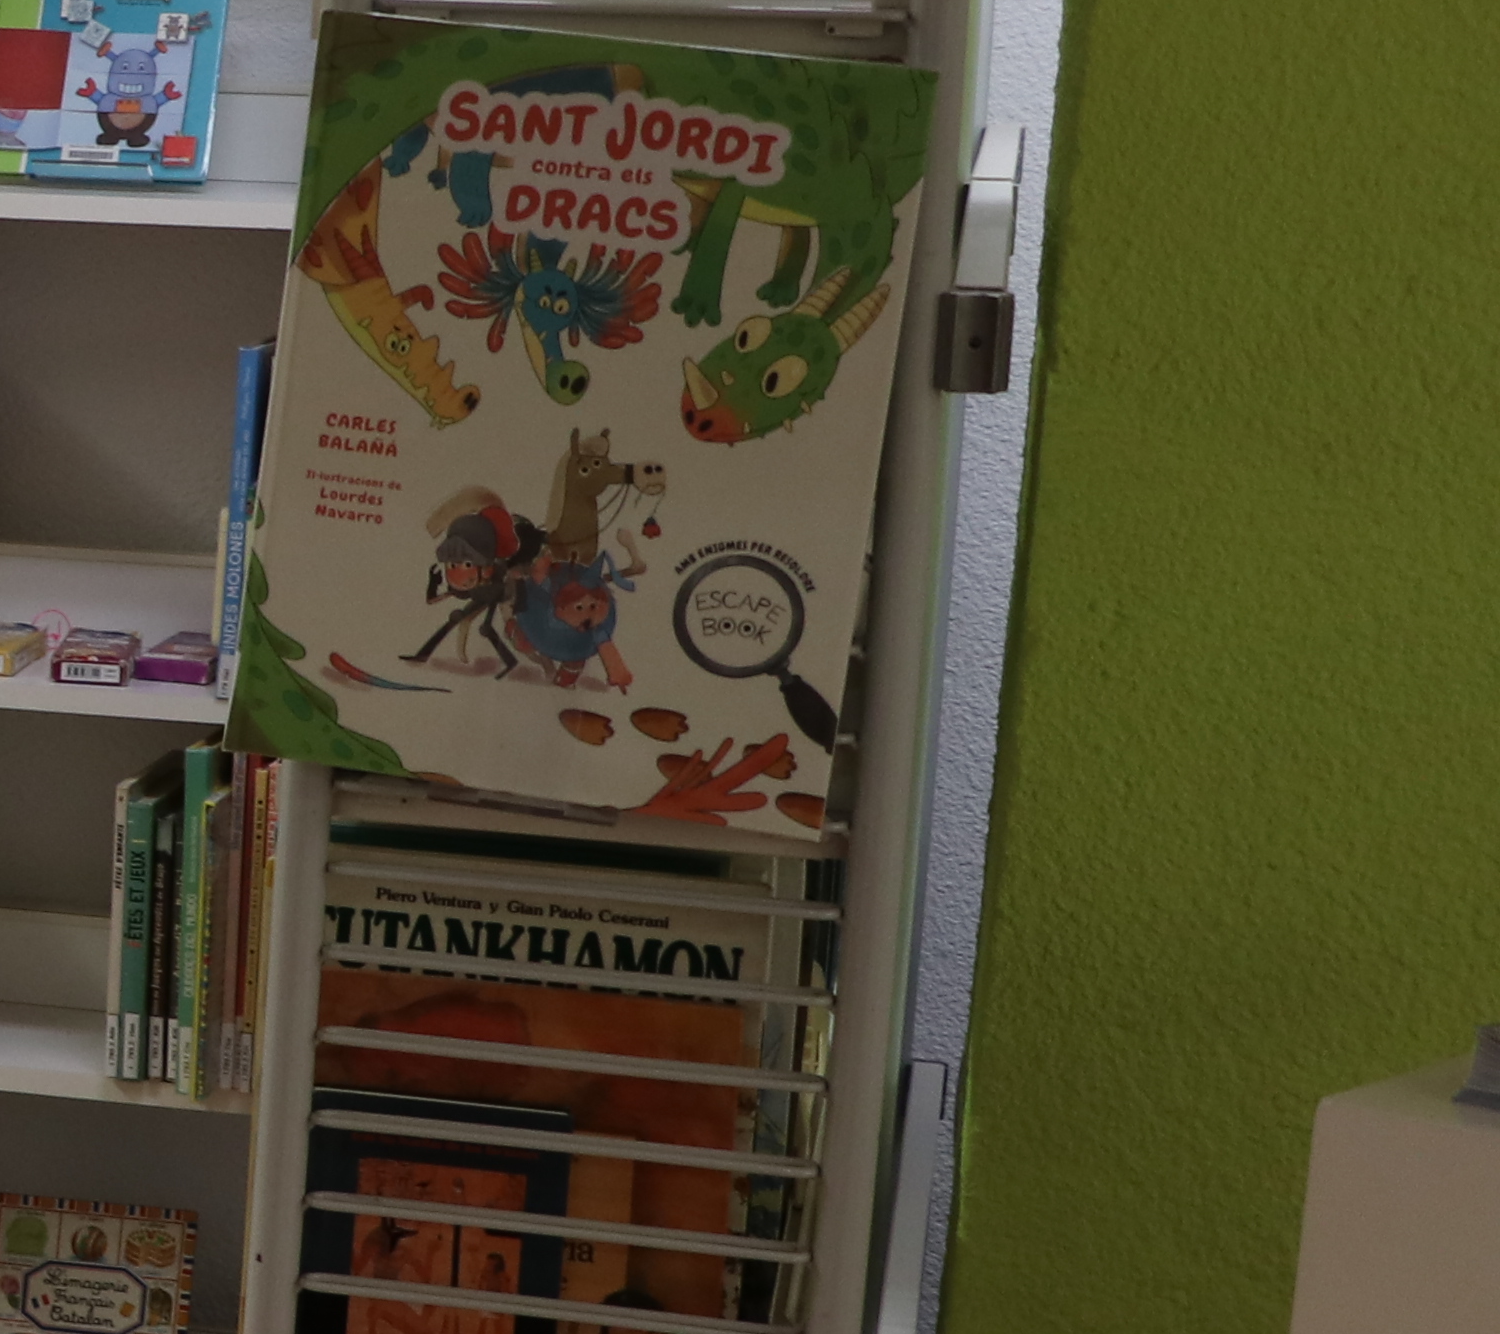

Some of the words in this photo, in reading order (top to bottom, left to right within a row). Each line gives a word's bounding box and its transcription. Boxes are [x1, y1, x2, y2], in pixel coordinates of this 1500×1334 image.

[444, 90, 598, 145] SANT
[604, 102, 779, 174] JORDI
[530, 157, 612, 182] contra
[620, 167, 654, 185] els
[504, 184, 679, 241] DRACS
[325, 410, 400, 435] CARLES
[317, 486, 385, 508] Lourdes
[314, 504, 385, 526] Navarro
[223, 520, 244, 598] MOLONES
[675, 553, 696, 575] AMB
[698, 540, 749, 557] ENIGMES
[750, 541, 773, 556] PER
[774, 549, 816, 594] RESOLDRE
[695, 590, 788, 626] ESCAPE
[701, 617, 773, 646] BOOK
[128, 850, 145, 884] JEUX
[129, 887, 144, 903] ET
[376, 886, 417, 904] Piero
[423, 891, 483, 910] Ventura
[489, 900, 499, 914] y
[507, 900, 543, 917] Gian
[549, 904, 593, 922] Paolo
[598, 910, 671, 930] Ceserani
